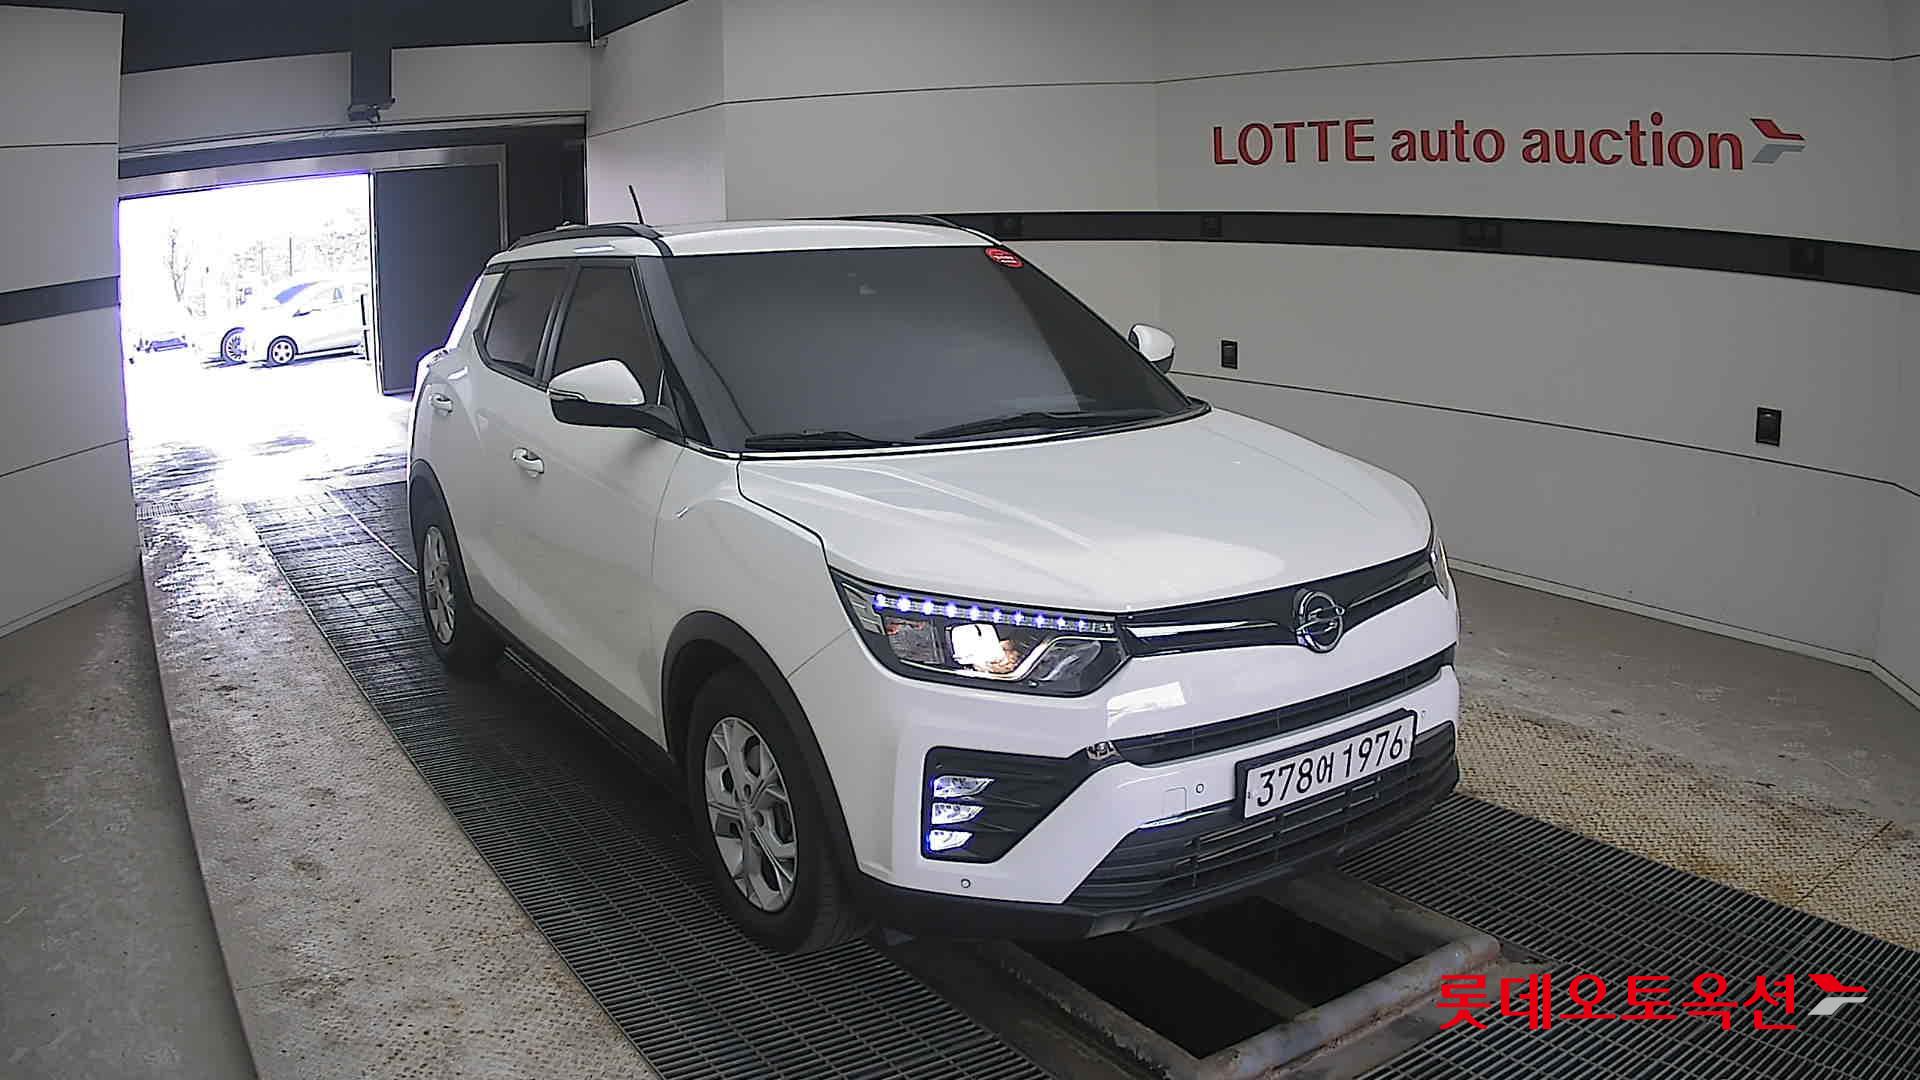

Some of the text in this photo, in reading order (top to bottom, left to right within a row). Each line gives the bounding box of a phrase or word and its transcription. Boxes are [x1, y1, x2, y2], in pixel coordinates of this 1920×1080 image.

[1213, 111, 1744, 170] LOTTE auto auction
